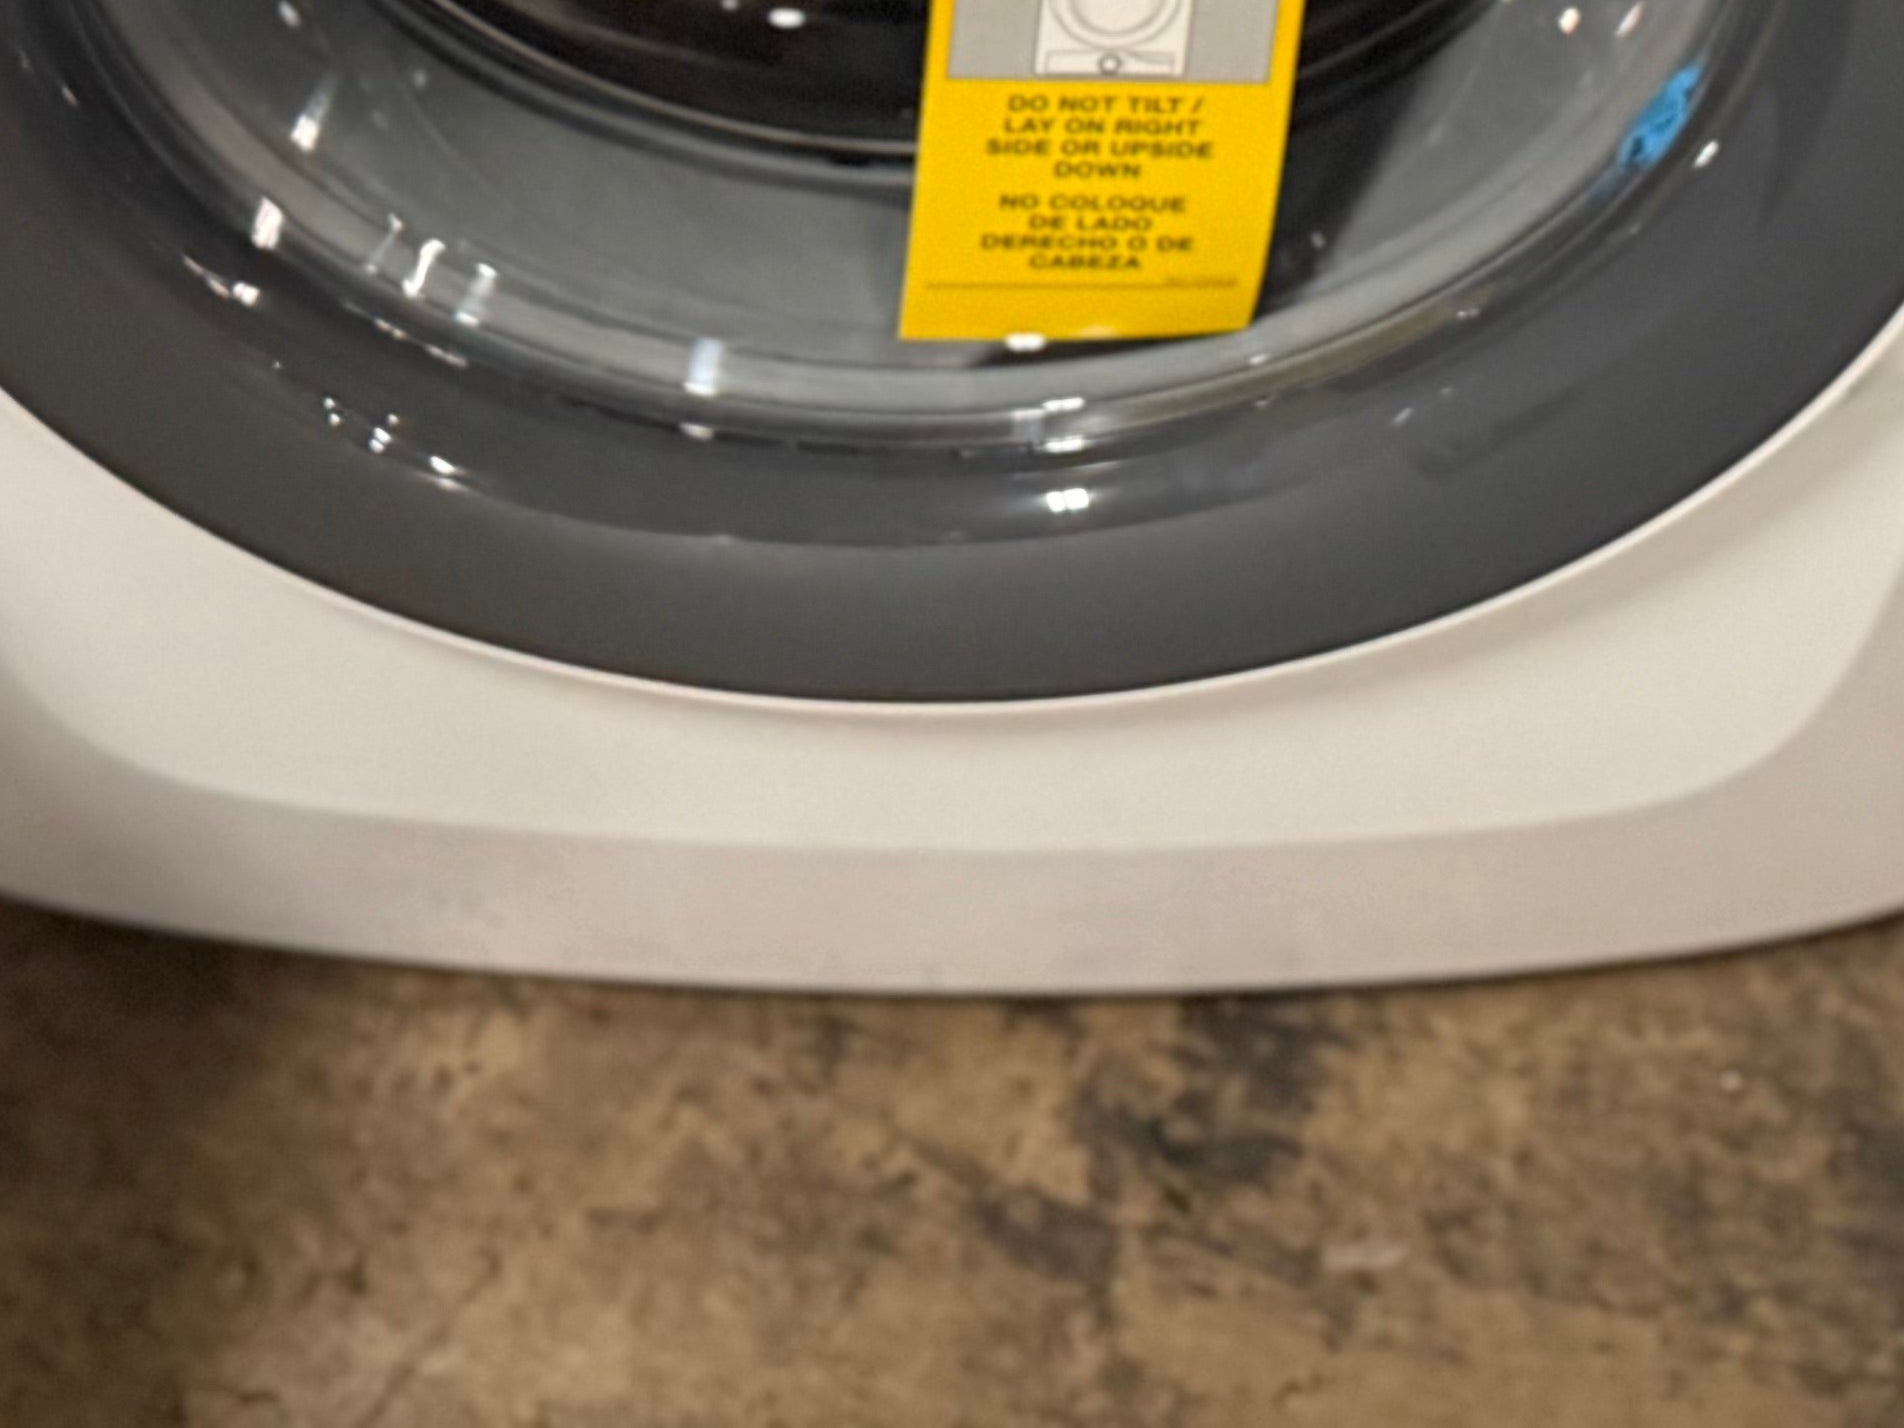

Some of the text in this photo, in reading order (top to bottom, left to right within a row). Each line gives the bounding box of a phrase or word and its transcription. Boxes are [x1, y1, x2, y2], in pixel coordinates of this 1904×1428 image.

[1008, 95, 1049, 113] DO
[1059, 96, 1117, 112] NOT
[1128, 97, 1183, 114] TILT
[1004, 117, 1201, 135] LAY ON RIGHT
[987, 139, 1213, 159] SIDE OR UPSIDE
[1053, 160, 1142, 178] DOWN
[1000, 194, 1186, 213] NO COLOQUE
[1029, 215, 1153, 232] DE LADO
[981, 234, 1118, 251] DERECHO
[1157, 236, 1192, 252] DE
[1029, 252, 1141, 270] CABEZA
